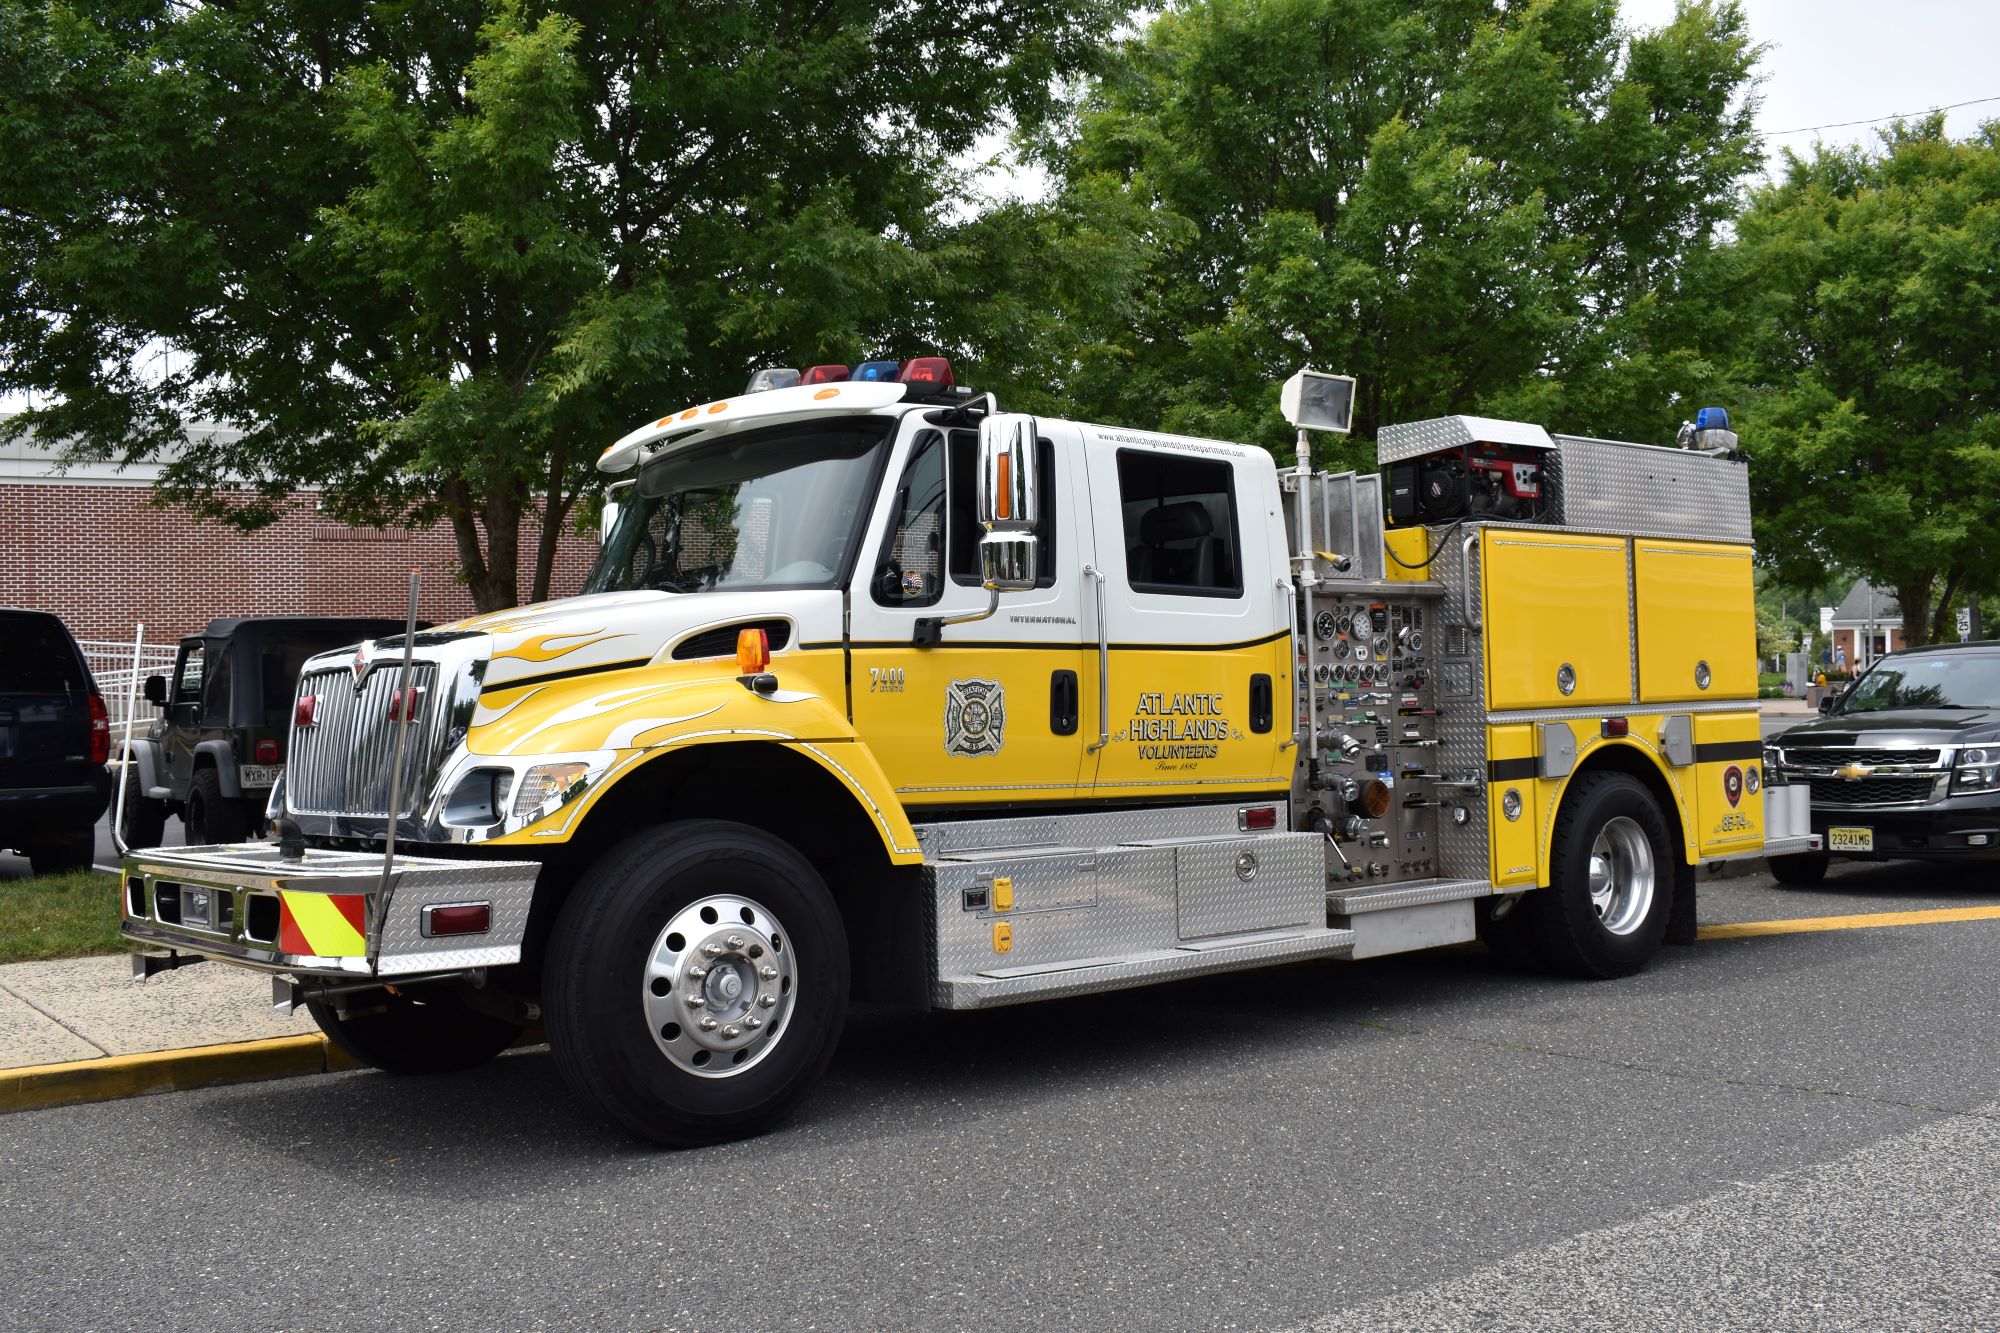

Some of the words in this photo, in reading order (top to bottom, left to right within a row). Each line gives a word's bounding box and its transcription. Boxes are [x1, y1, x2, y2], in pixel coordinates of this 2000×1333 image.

[1009, 614, 1077, 625] INTERNATIONAL
[1958, 621, 1968, 631] 25
[869, 666, 905, 692] 7400
[963, 686, 988, 696] STATION
[1135, 692, 1223, 716] ATLANTIC
[1129, 719, 1229, 741] HIGHLANDS
[1138, 744, 1218, 760] VOLUNTEERS
[1155, 761, 1177, 771] Since
[1179, 763, 1198, 771] 1882
[1832, 833, 1870, 846] 23241MG
